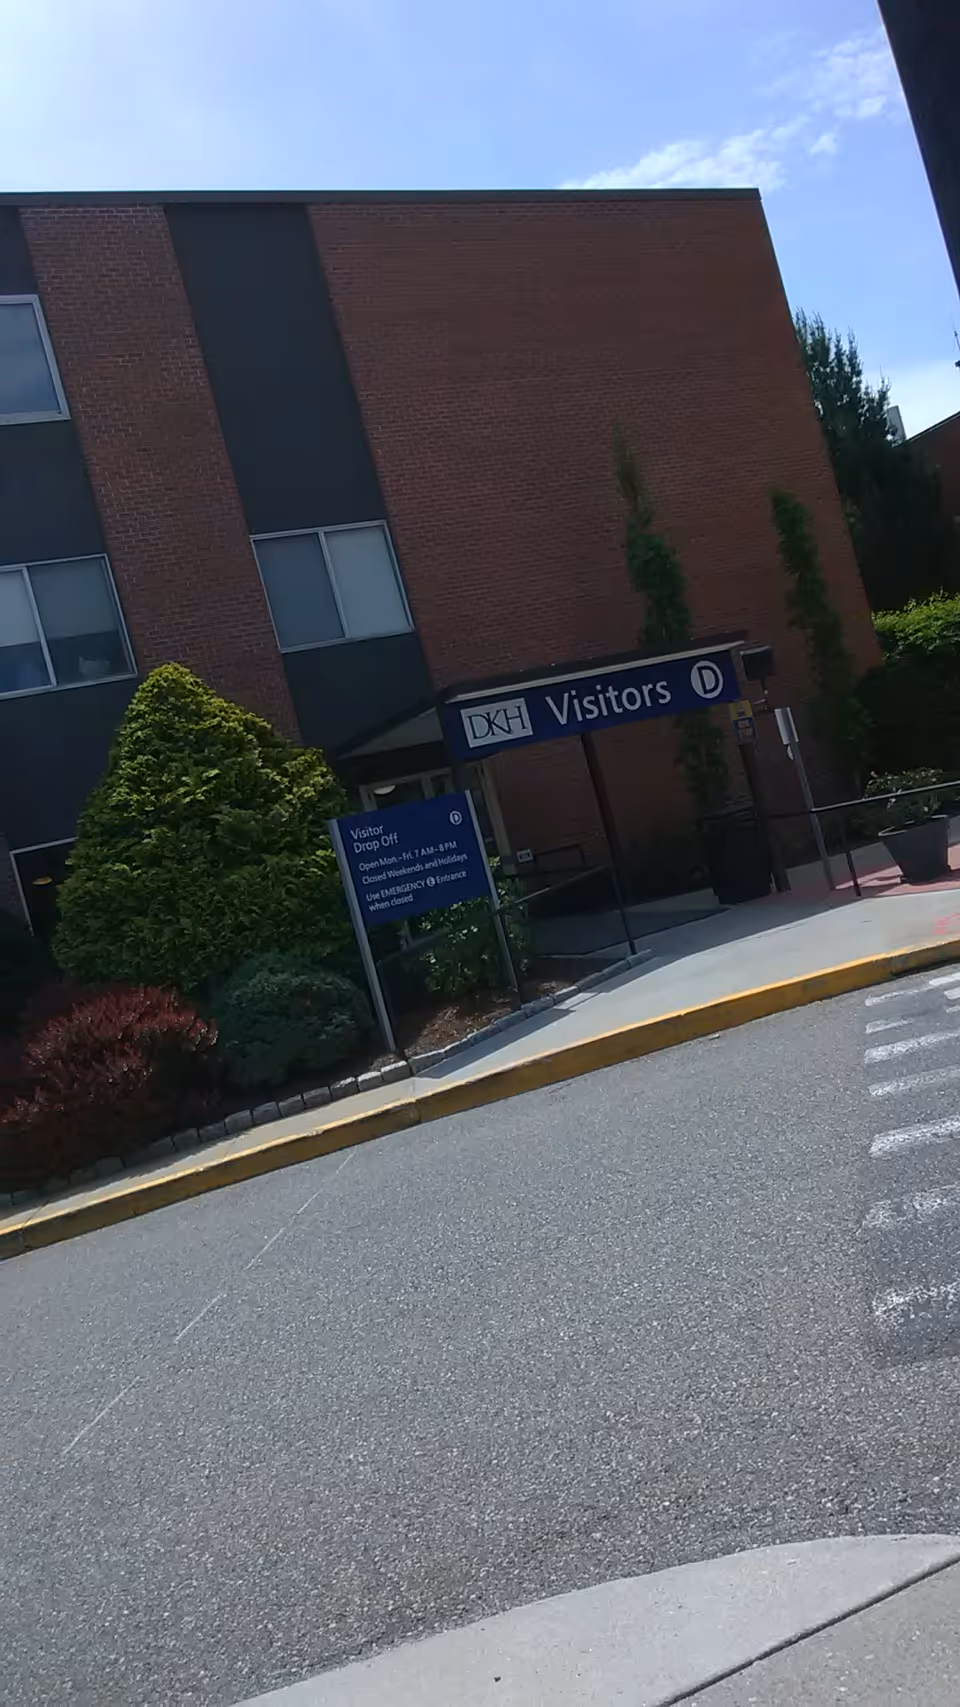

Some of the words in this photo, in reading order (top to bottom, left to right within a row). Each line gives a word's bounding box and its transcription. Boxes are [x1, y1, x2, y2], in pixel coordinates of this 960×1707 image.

[467, 706, 528, 740] DKH
[545, 679, 672, 726] Visitors
[350, 825, 384, 839] Visitor
[354, 840, 380, 853] Drop
[381, 833, 399, 846] Off
[359, 860, 380, 871] Open
[414, 850, 419, 858] 7
[444, 841, 457, 851] PM
[362, 874, 387, 885] Closed
[387, 863, 424, 878] Weekends
[424, 859, 439, 870] and
[438, 853, 468, 867] Holidays
[366, 893, 381, 902] Use
[381, 880, 426, 897] EMERGENCY
[436, 871, 467, 884] Entrance
[369, 901, 391, 912] when
[391, 894, 414, 906] closed
